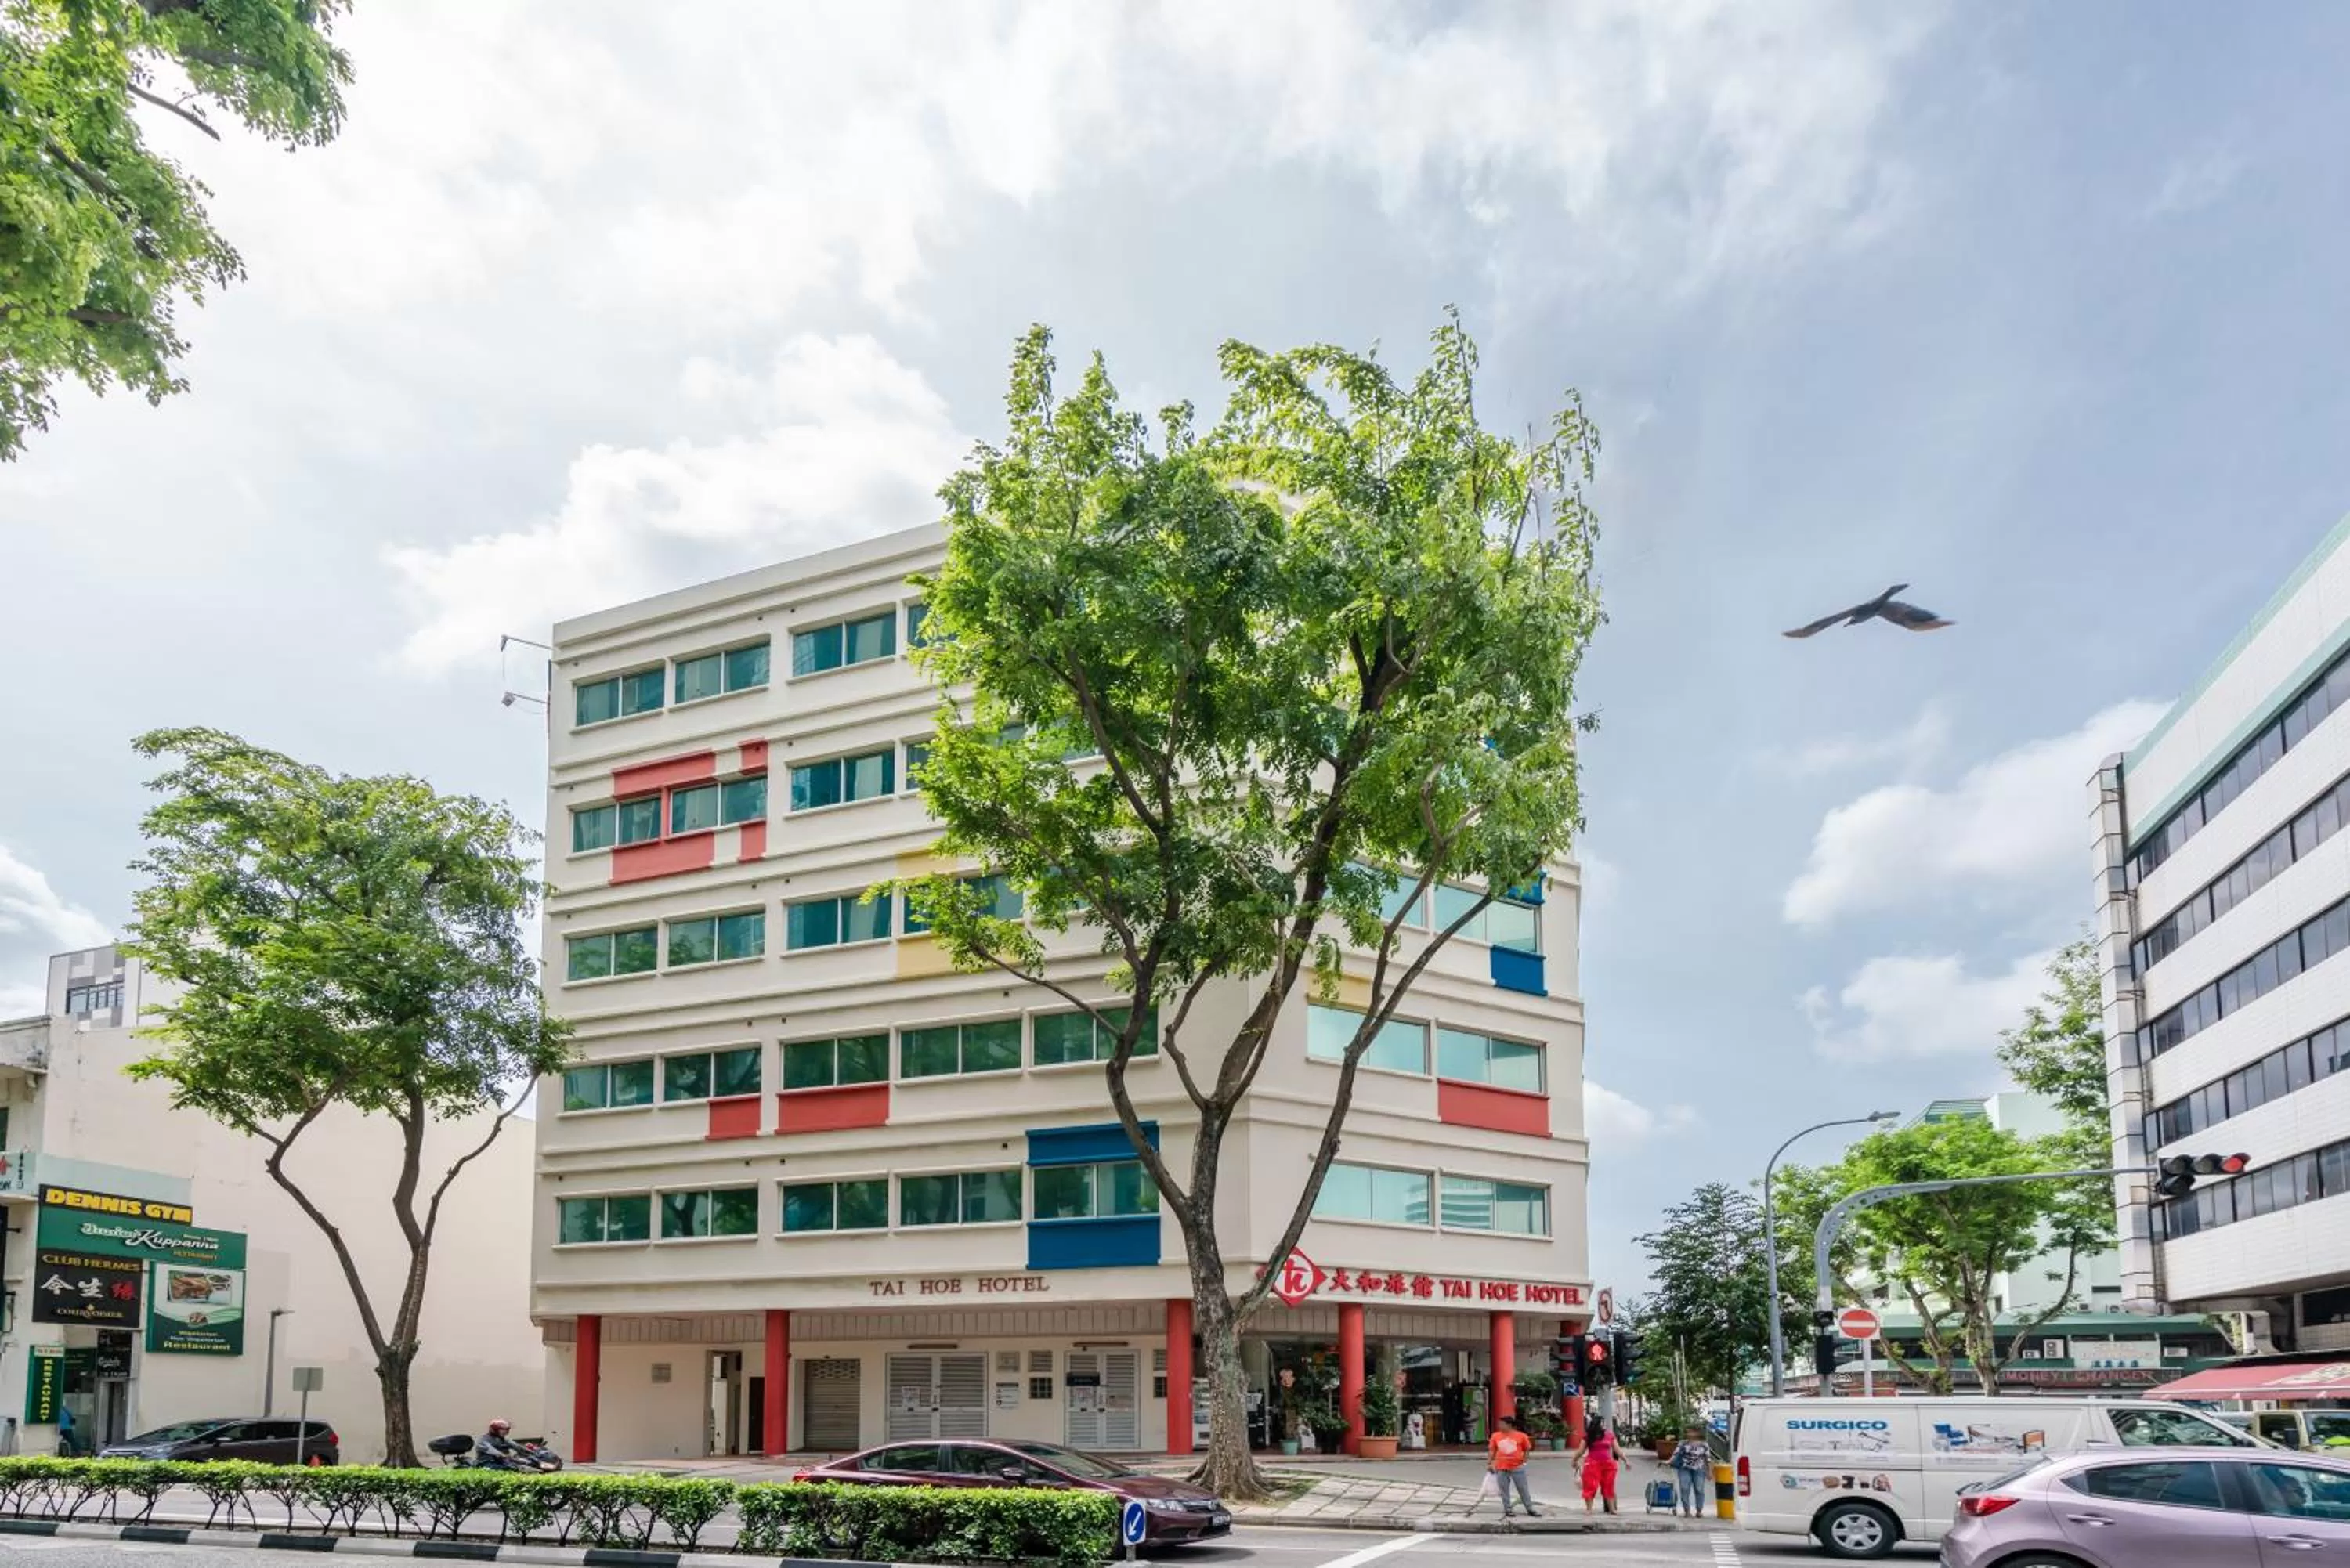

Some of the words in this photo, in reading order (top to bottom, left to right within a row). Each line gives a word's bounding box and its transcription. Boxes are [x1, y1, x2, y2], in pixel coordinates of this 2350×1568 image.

[45, 1188, 142, 1215] DENNIS
[145, 1205, 192, 1223] GYM
[42, 1254, 81, 1266] CLUB
[84, 1258, 140, 1272] HERMES
[870, 1281, 906, 1296] TAI
[920, 1278, 963, 1295] HOE
[978, 1276, 1050, 1292] HOTEL
[1440, 1279, 1472, 1298] TAI
[1479, 1281, 1519, 1302] HOE
[1525, 1284, 1584, 1305] HOTEL
[2005, 1371, 2058, 1382] MONEY
[2075, 1371, 2154, 1382] CHANGER
[39, 1358, 54, 1422] RESTAURANT
[1786, 1420, 1888, 1429] SURGICO
